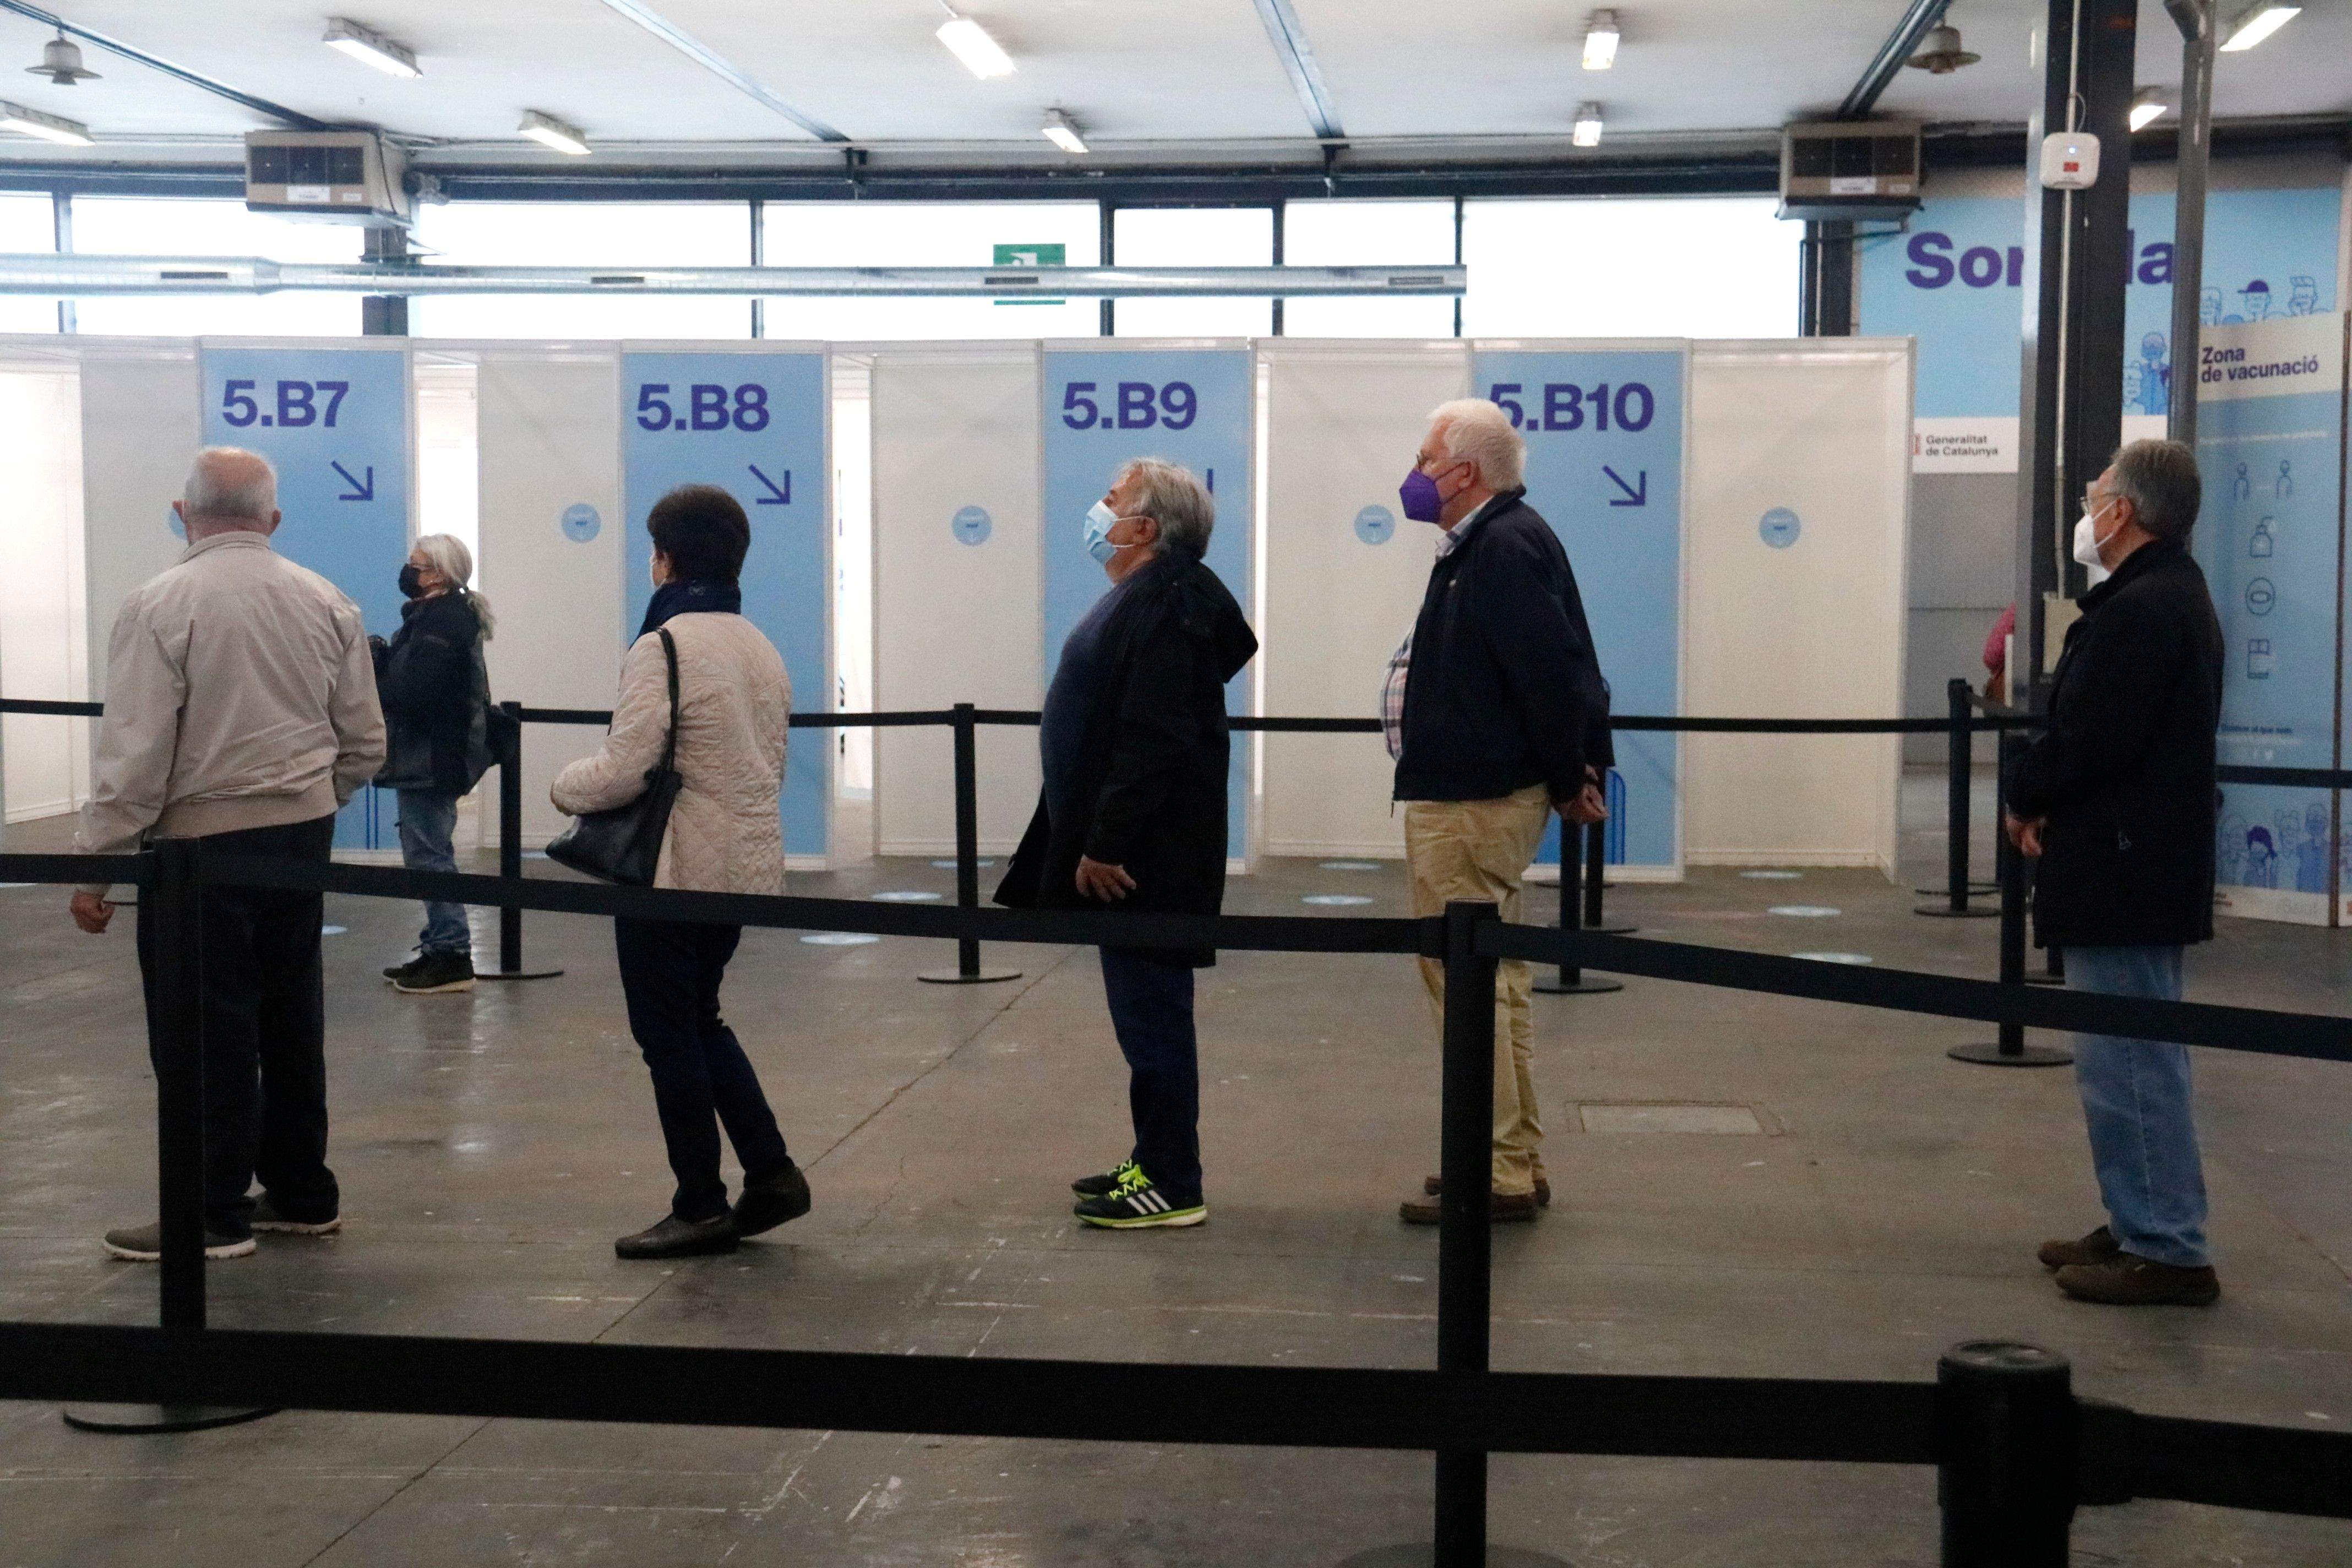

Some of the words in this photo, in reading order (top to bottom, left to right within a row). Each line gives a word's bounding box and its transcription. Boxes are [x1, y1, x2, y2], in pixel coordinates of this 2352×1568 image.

[2201, 366, 2222, 383] de
[2227, 354, 2319, 380] vacunació
[2202, 346, 2246, 364] Zona
[222, 379, 349, 427] 5.B7
[636, 383, 770, 432] 5.B8
[1062, 381, 1197, 430] 5.B9
[1489, 382, 1654, 432] 5.B10
[1926, 434, 1988, 444] Generalitat
[1926, 447, 1939, 456] de
[1942, 447, 1999, 457] Catalunya
